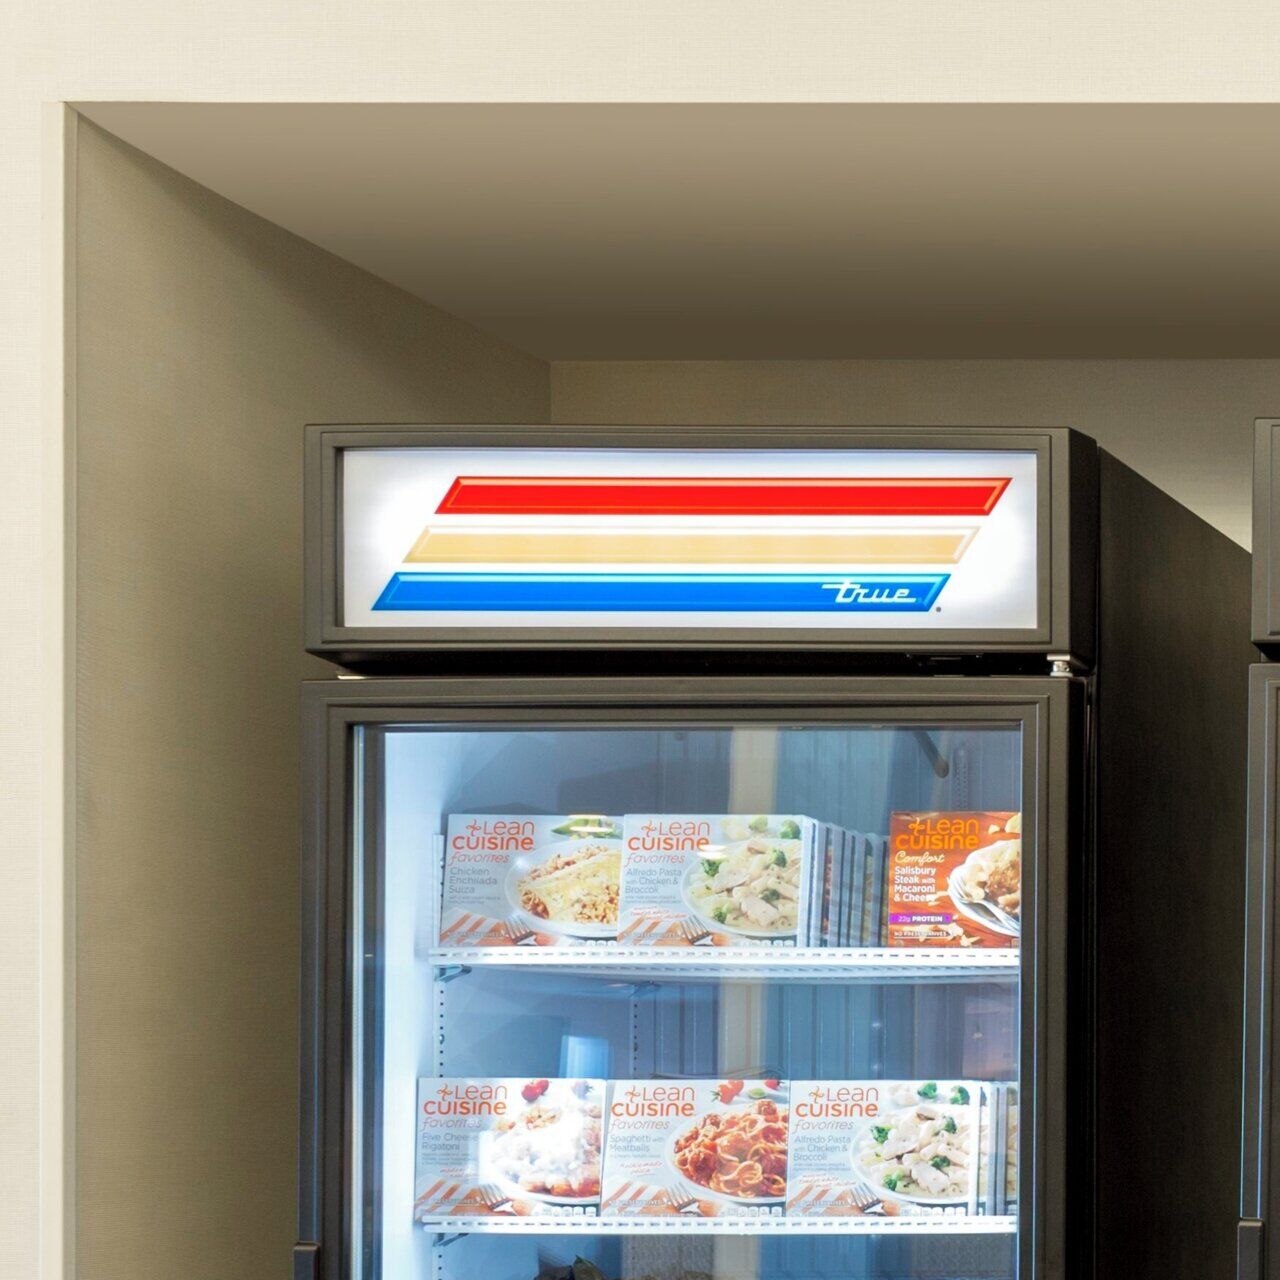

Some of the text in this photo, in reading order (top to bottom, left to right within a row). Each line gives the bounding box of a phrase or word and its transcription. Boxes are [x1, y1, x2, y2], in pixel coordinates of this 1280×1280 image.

[822, 579, 917, 604] true
[895, 851, 945, 865] Comfort
[894, 866, 936, 875] Salisbury
[450, 876, 498, 886] Enchilada
[894, 876, 919, 884] Steak
[894, 884, 935, 893] Macaroni
[826, 1087, 878, 1101] Lean
[611, 1102, 695, 1117] cuisine
[795, 1103, 878, 1117] cuisine
[610, 1134, 651, 1145] Spaghetti
[794, 1135, 851, 1143] Alfredo Pasta
[610, 1143, 649, 1152] Meatballs
